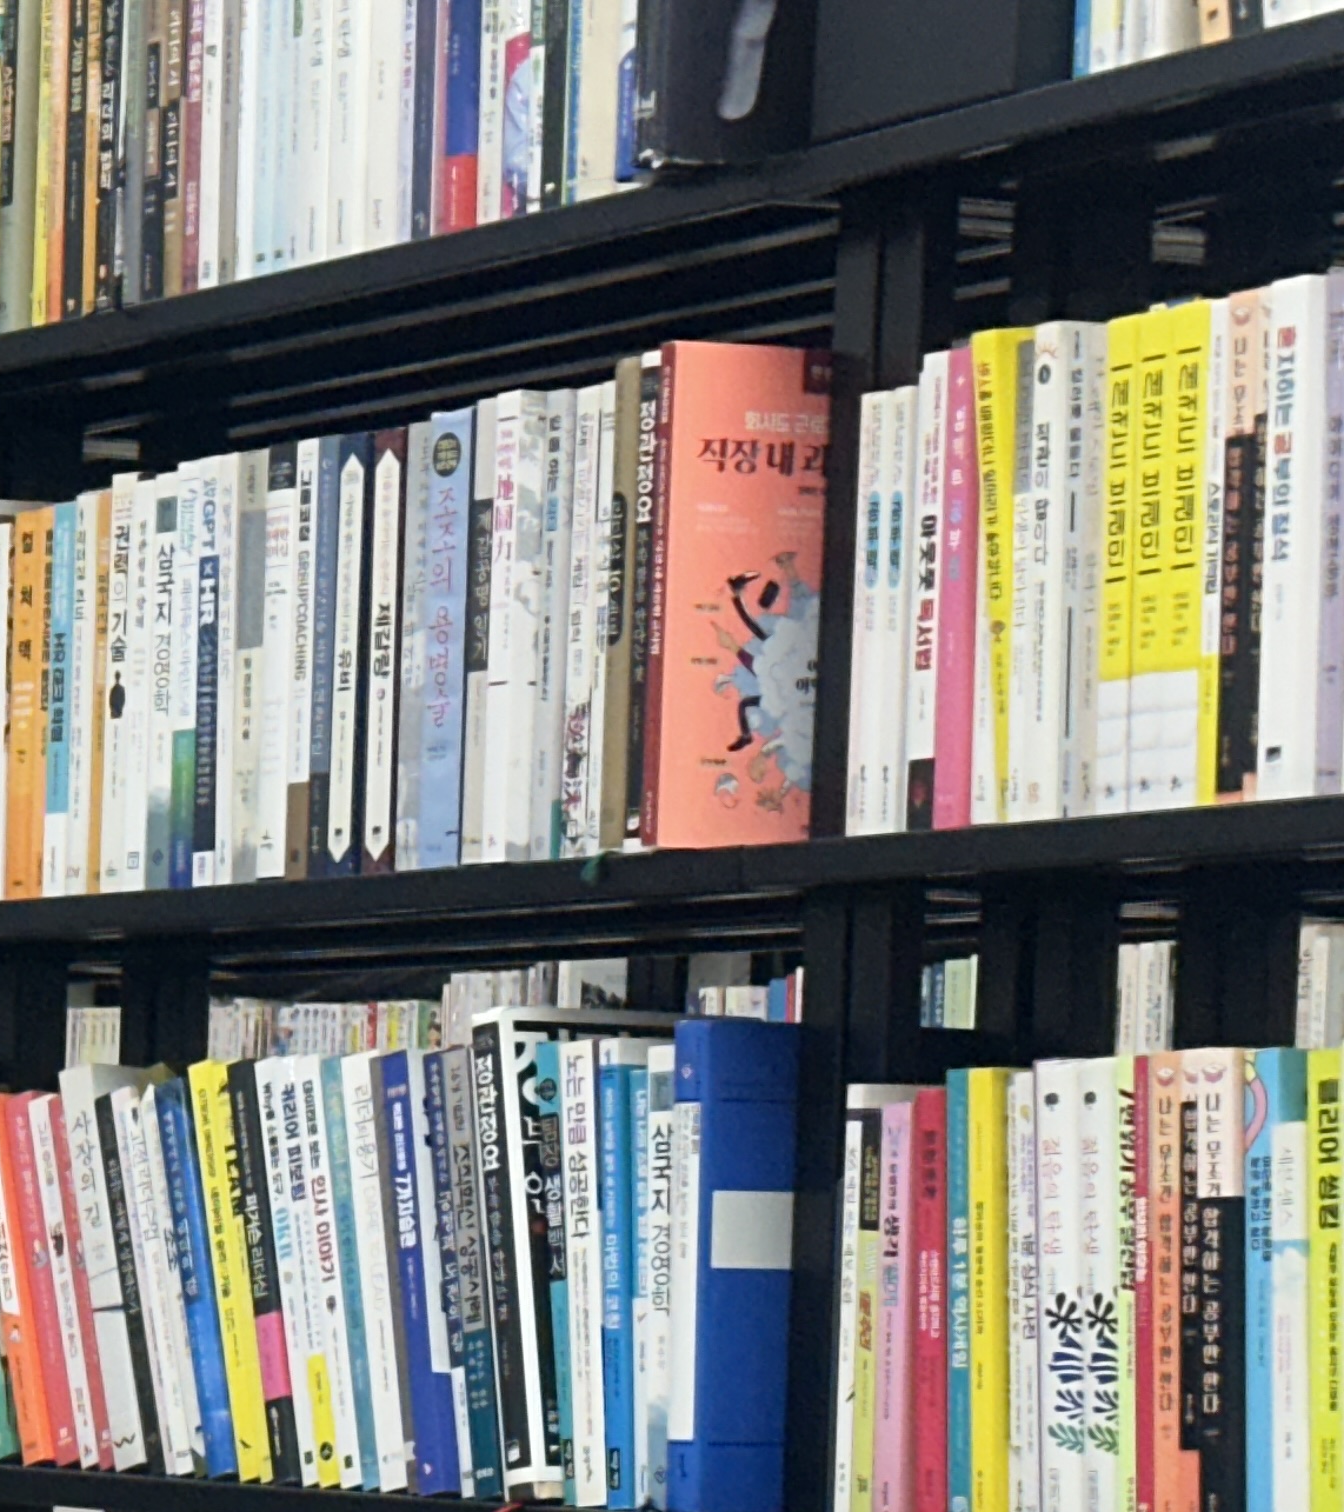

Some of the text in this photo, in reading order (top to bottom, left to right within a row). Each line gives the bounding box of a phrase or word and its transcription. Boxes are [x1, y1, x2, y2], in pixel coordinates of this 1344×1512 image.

[1274, 327, 1296, 428] 혼자하는
[637, 400, 656, 523] 정관정요
[696, 438, 795, 474] 직장 내
[431, 487, 458, 593] 조조의
[111, 526, 131, 663] 권력의 기술
[52, 633, 66, 663] HR
[154, 542, 175, 716] 삼국지 경영학
[374, 603, 391, 680] 제갈량
[916, 598, 934, 671] 독서법
[337, 649, 352, 692] 유비
[281, 1084, 299, 1140] 커리어
[475, 1054, 500, 1172] 정관정요
[1159, 1097, 1171, 1137] 나는
[1205, 1093, 1221, 1135] 나는
[70, 1111, 95, 1193] 사장의
[566, 1054, 591, 1238] 노는 만큼 성공한다
[312, 1176, 330, 1217] 인사
[651, 1122, 673, 1318] 삼국지 경영학
[1318, 1174, 1338, 1230] 씽킹
[274, 1208, 292, 1261] OKR
[316, 1222, 336, 1283] 이야기
[951, 1218, 968, 1256] 하루
[250, 1247, 269, 1298] 리더십
[1021, 1234, 1036, 1340] 1분 상식 사전
[1159, 1372, 1172, 1413] 한다
[1202, 1372, 1219, 1415] 한다
